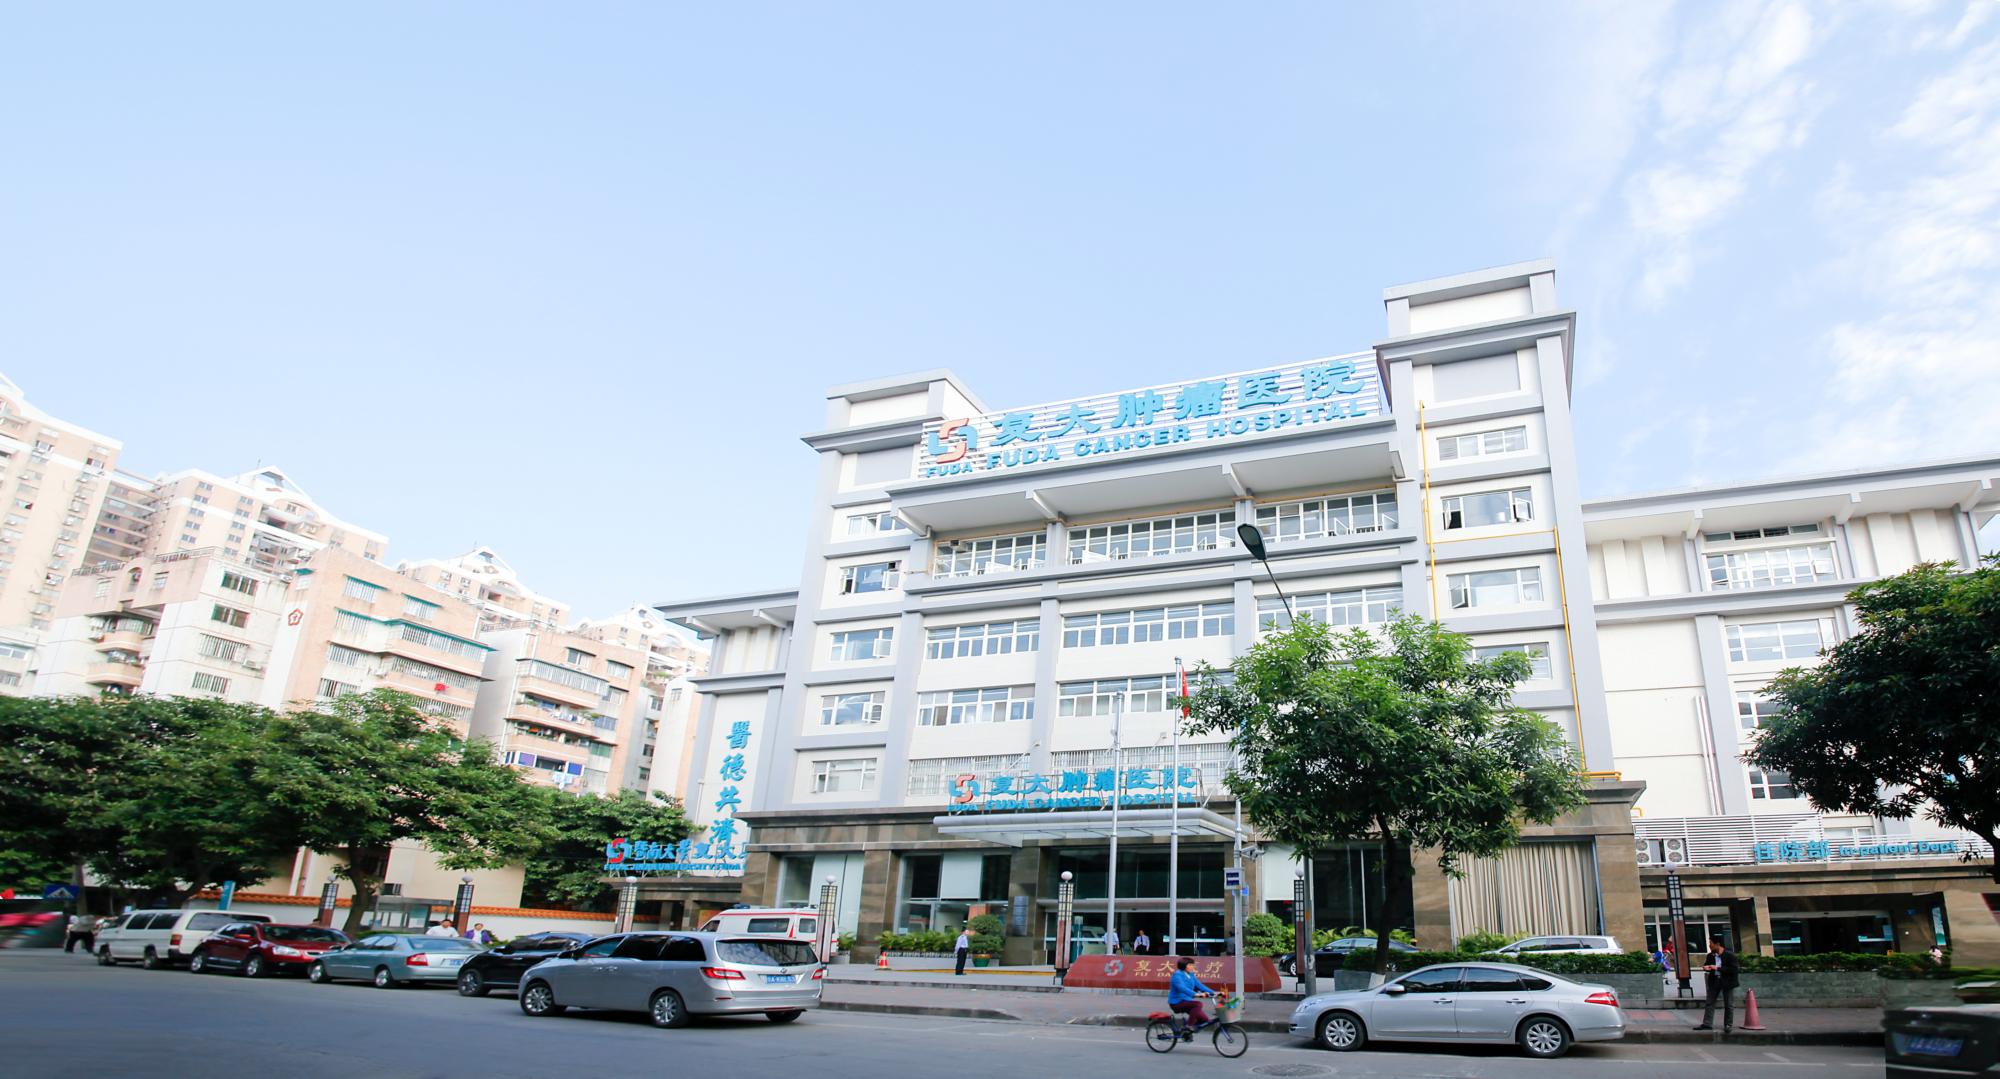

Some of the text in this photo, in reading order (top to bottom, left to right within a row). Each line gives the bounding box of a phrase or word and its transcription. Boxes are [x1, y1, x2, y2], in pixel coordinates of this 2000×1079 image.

[990, 360, 1366, 446] 复大肿瘤医院
[986, 399, 1368, 470] FUDA CANCER HOSPITAL
[926, 462, 973, 478] FUDA
[989, 767, 1197, 795] 复大肿瘤医院
[1033, 796, 1101, 809] CANCER
[1754, 840, 1830, 862] 住院部
